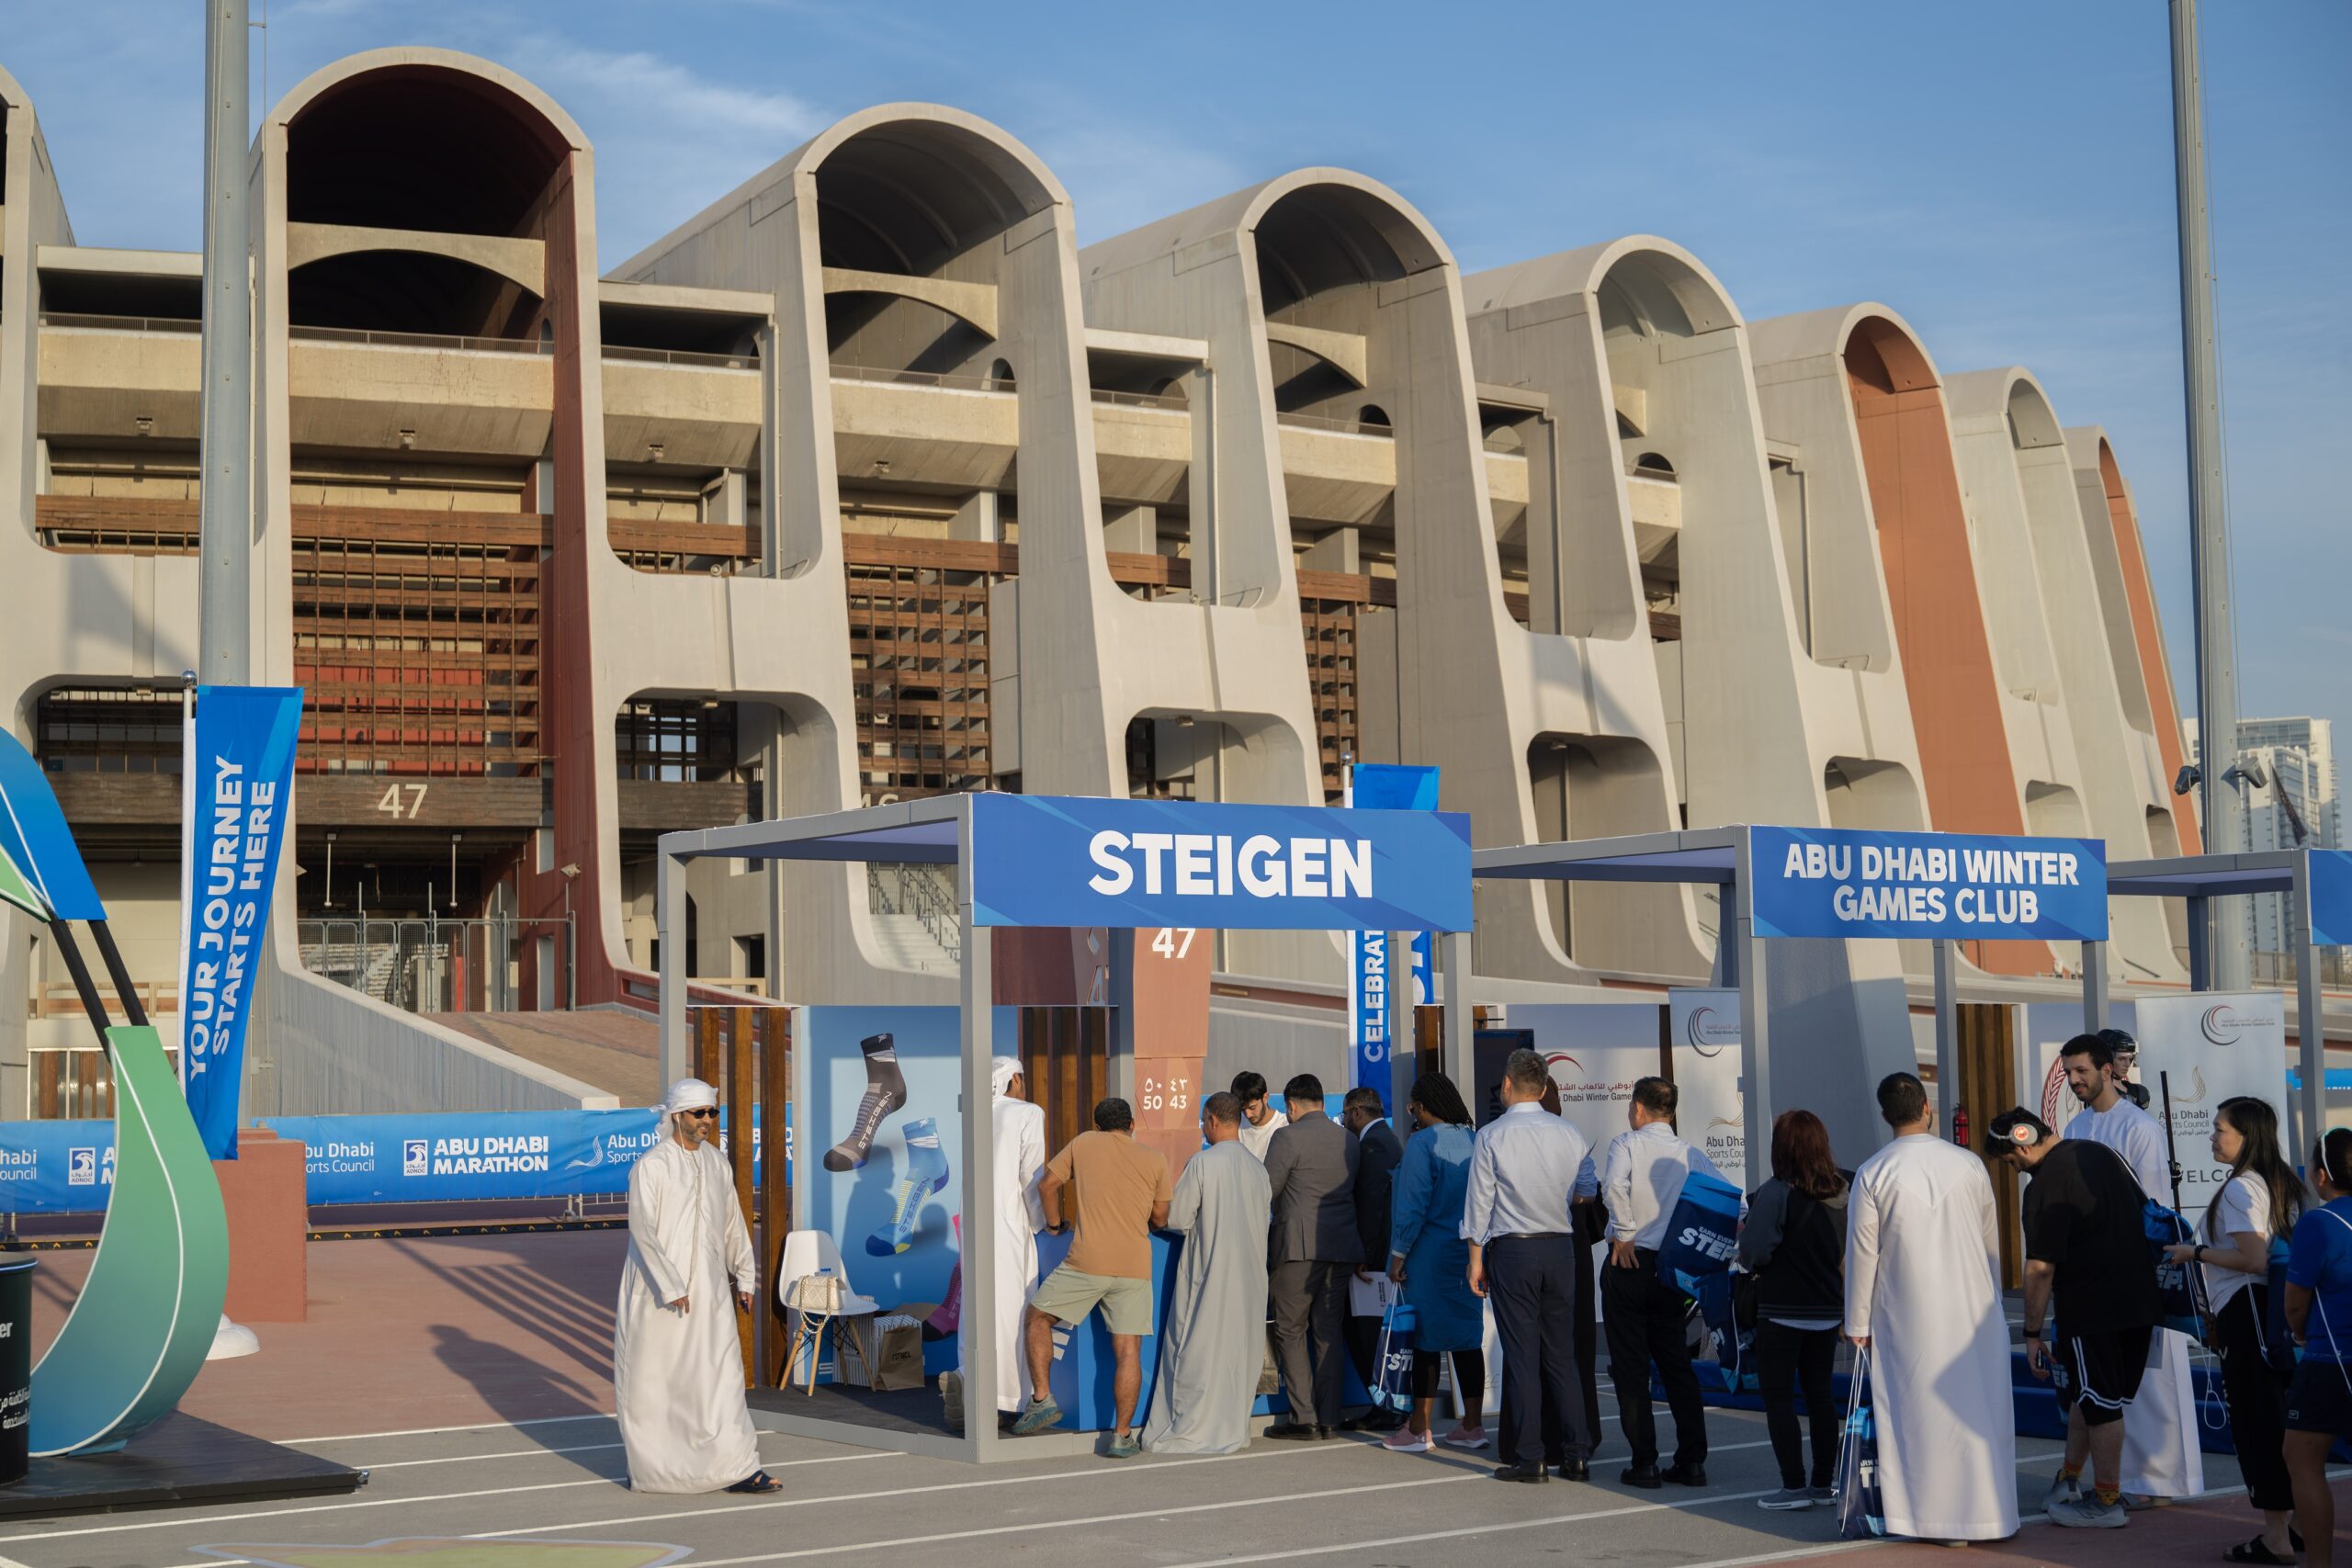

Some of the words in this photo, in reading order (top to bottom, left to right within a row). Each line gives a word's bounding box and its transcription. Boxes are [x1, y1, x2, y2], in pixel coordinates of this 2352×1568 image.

[378, 784, 428, 818] 47
[198, 755, 243, 952] JOURNEY
[1088, 829, 1373, 898] STEIGEN
[1783, 843, 1851, 881] ABU
[1861, 845, 1956, 882] DHABI
[1963, 850, 2079, 886] WINTER
[1833, 885, 1947, 923] GAMES
[1955, 888, 2039, 924] CLUB
[212, 901, 256, 1055] STARTS
[240, 781, 276, 890] HERE
[1152, 928, 1195, 958] 47
[1363, 930, 1385, 1063] CELEBRAT
[190, 962, 220, 1082] YOUR
[1143, 1095, 1162, 1110] 50
[1170, 1095, 1187, 1110] 43
[1563, 1094, 1584, 1102] Dhabi
[1586, 1093, 1609, 1101] Winter
[1611, 1092, 1632, 1100] Game
[858, 1090, 892, 1150] STEIGEN
[2158, 1111, 2177, 1120] Au
[2180, 1110, 2209, 1120] Dhabi
[2183, 1120, 2209, 1128] Council
[305, 1143, 322, 1158] bu
[329, 1142, 374, 1157] Dhabi
[433, 1138, 478, 1156] ABU
[482, 1136, 548, 1154] DHABI
[607, 1134, 636, 1148] Abu
[1706, 1135, 1724, 1147] Abu
[1726, 1135, 1745, 1147] Dha
[0, 1149, 37, 1165] habi
[1706, 1148, 1728, 1159] Sports
[0, 1168, 37, 1180] ouncil
[305, 1160, 330, 1174] orts
[332, 1159, 375, 1173] Council
[433, 1156, 548, 1175] MARATHON
[899, 1176, 931, 1234] STEIGEN
[1698, 1225, 1716, 1238] EARN
